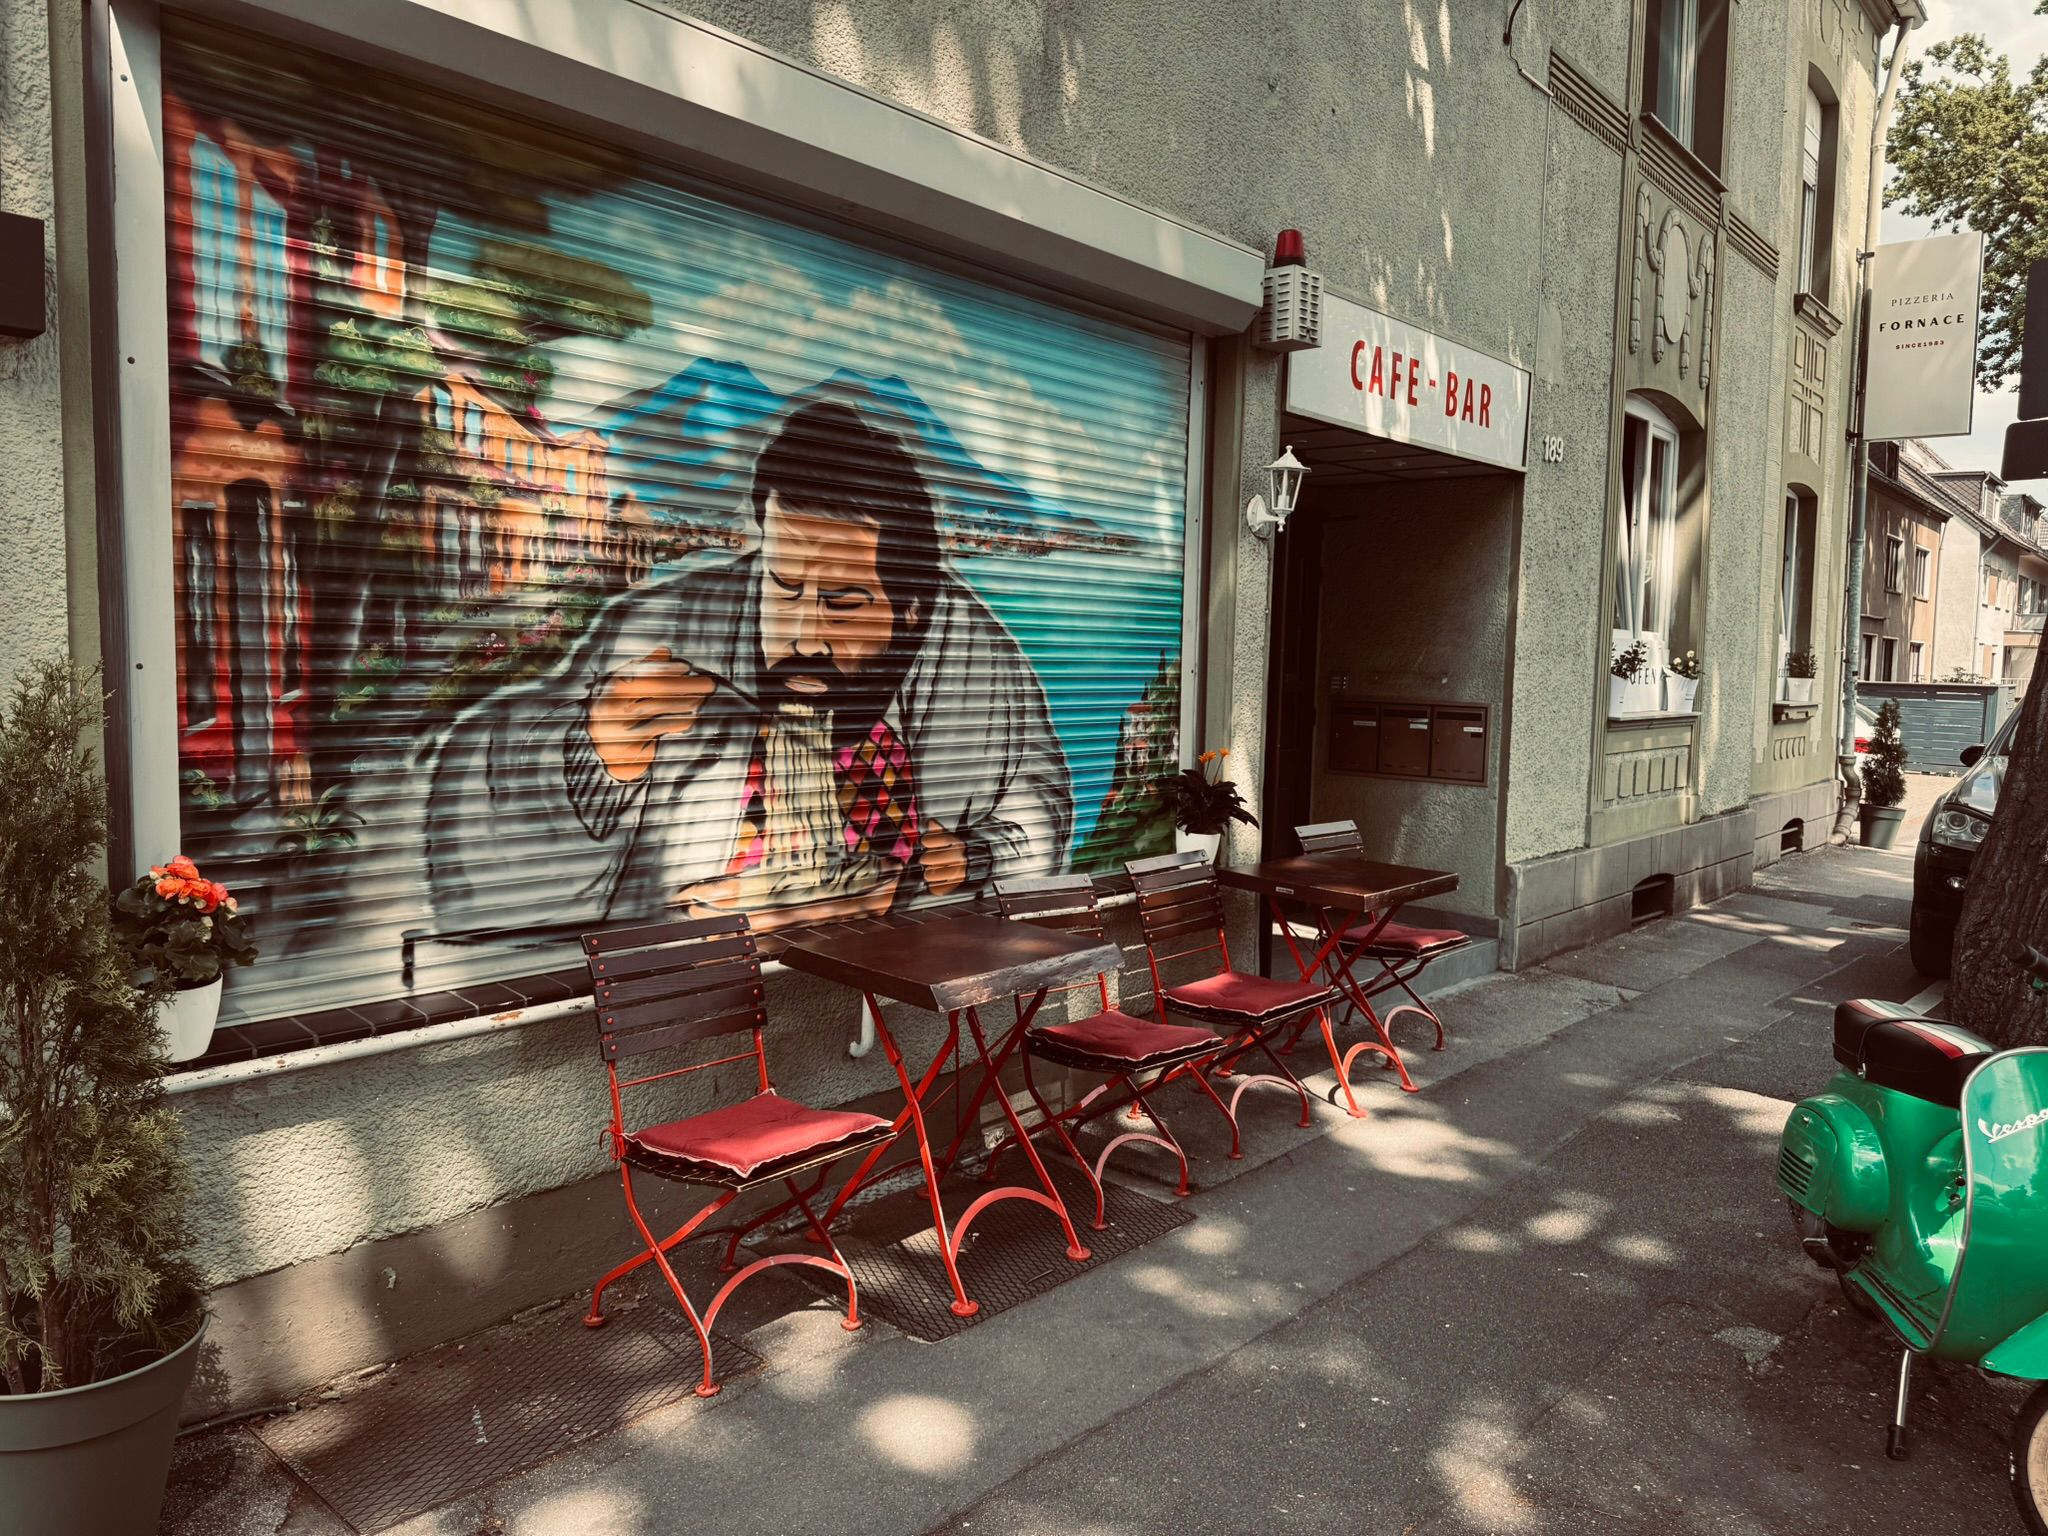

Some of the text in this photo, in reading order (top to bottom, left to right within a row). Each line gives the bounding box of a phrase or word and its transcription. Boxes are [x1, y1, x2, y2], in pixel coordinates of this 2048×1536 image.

[1891, 292, 1954, 307] PIZZERIA
[1879, 313, 1965, 332] FORNACE
[1544, 435, 1564, 462] 189
